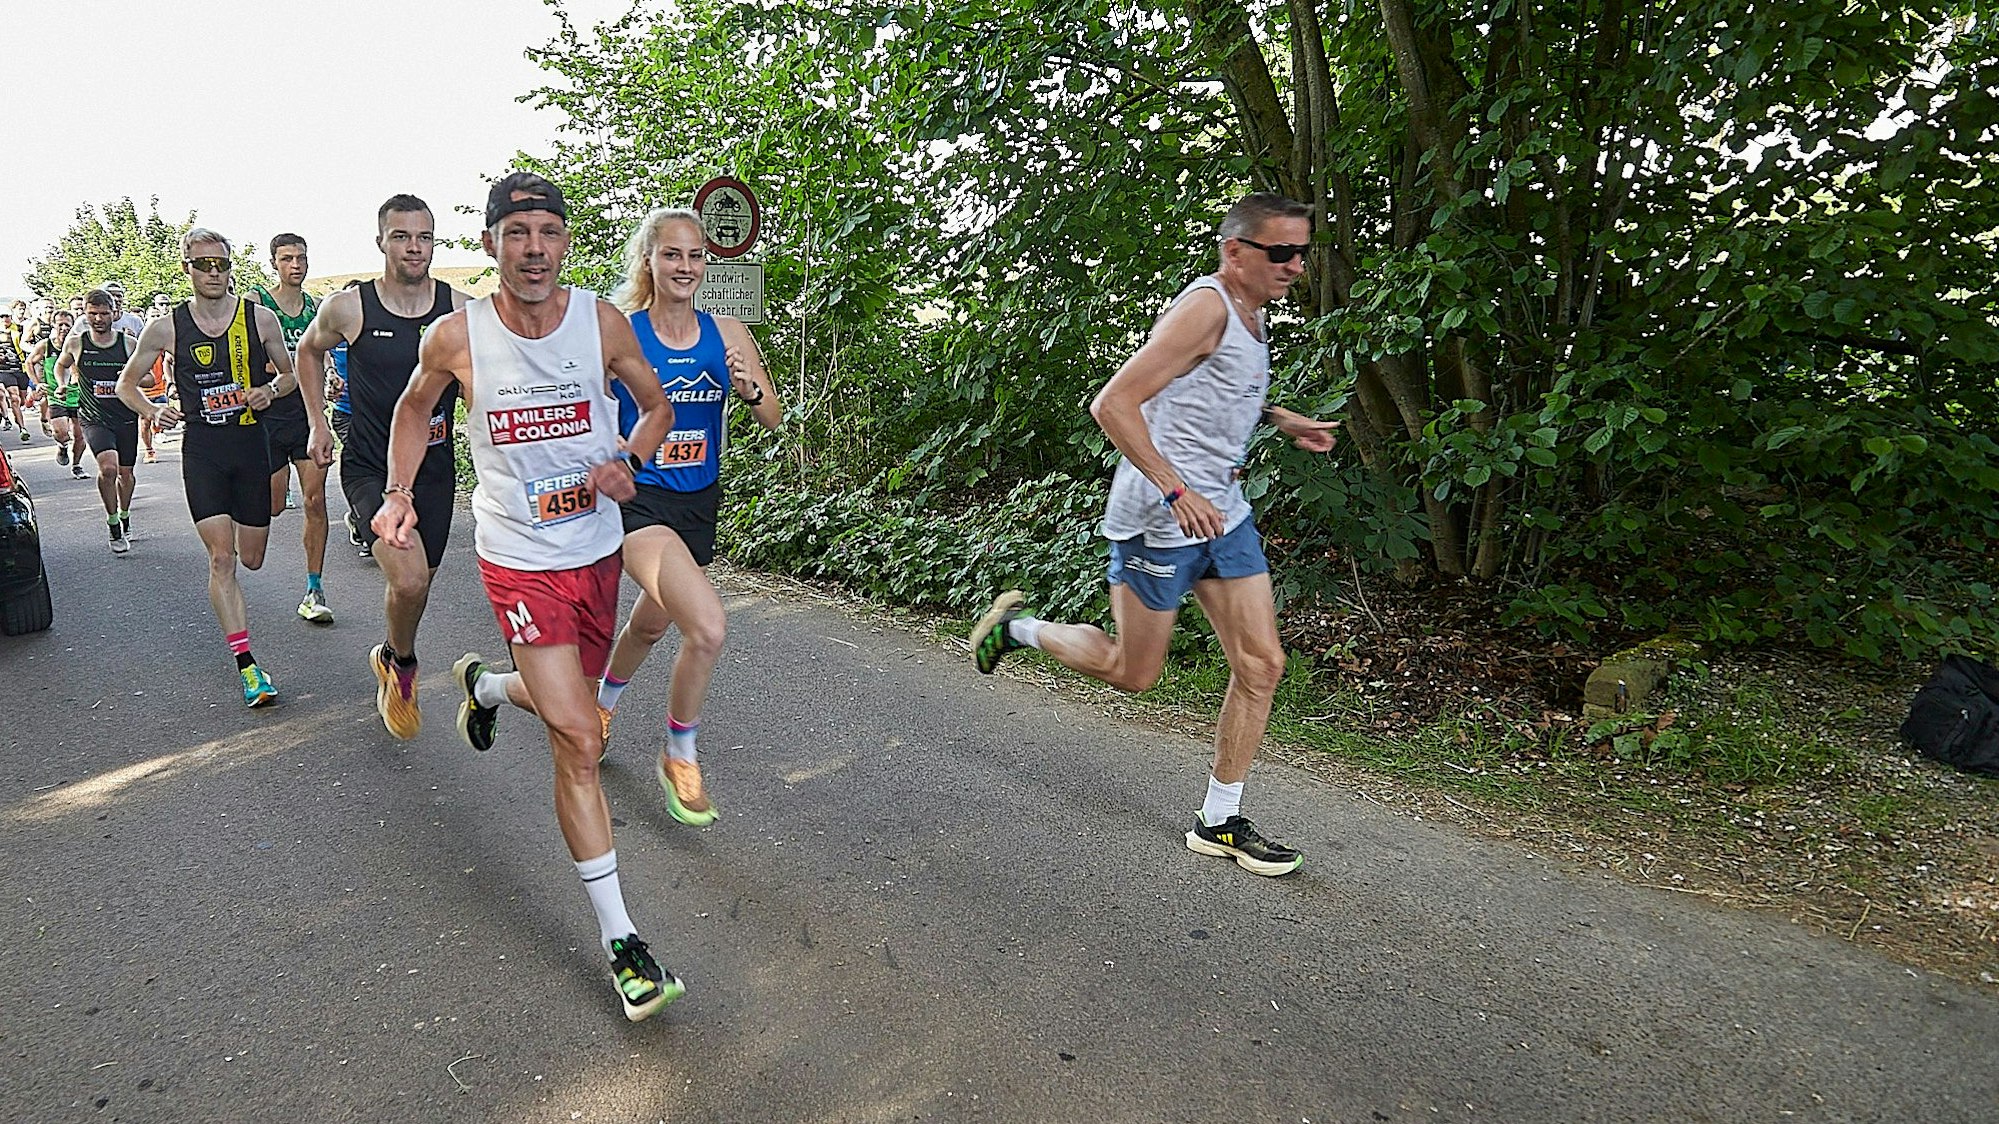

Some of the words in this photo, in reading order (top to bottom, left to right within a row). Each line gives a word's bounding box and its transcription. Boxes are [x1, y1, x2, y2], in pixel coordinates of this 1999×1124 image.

[706, 271, 750, 283] Landwirt-
[701, 287, 754, 300] schaftlicher
[701, 304, 736, 316] Verkehr
[740, 304, 755, 316] frei
[204, 383, 237, 395] PETERS
[665, 389, 723, 403] -KELLER
[211, 392, 239, 409] 341
[513, 405, 577, 425] MILERS
[514, 419, 590, 441] COLONIA
[668, 442, 703, 461] 437
[534, 471, 589, 494] PETERS
[546, 488, 592, 515] 456
[505, 600, 533, 632] M
